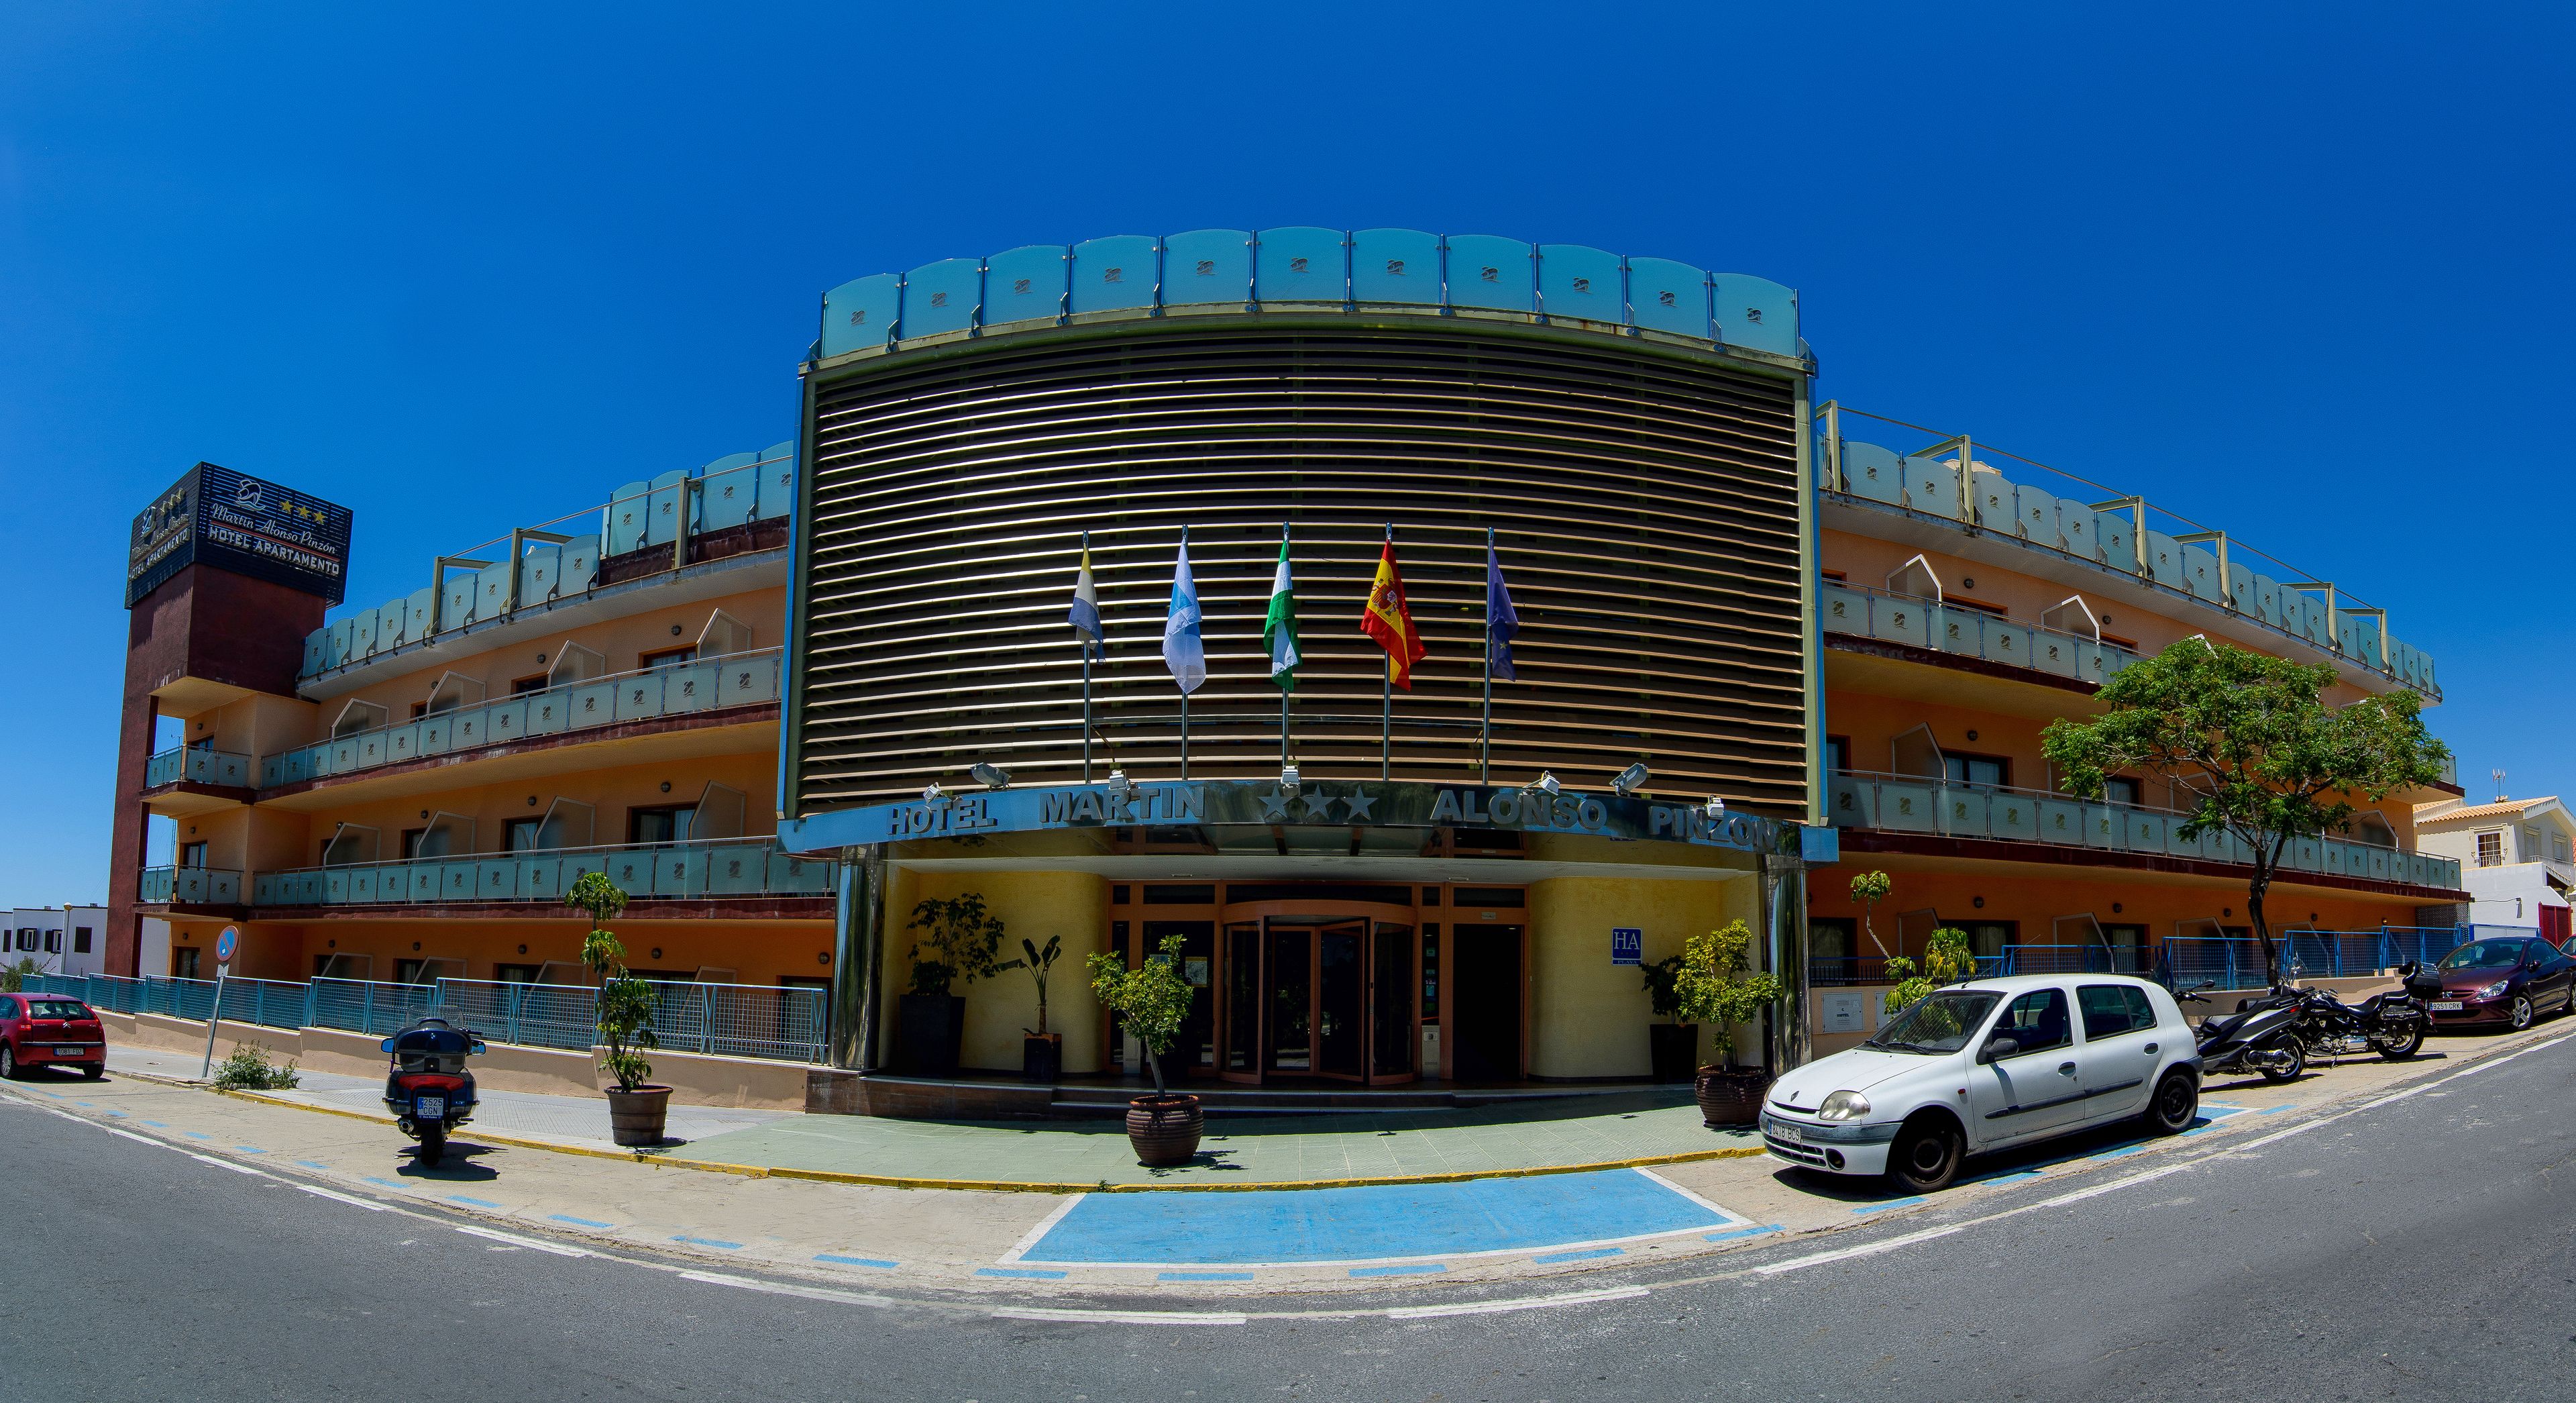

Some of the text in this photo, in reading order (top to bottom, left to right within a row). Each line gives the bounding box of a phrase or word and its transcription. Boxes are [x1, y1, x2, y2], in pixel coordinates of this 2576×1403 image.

[256, 519, 298, 542] Alonso
[299, 530, 337, 554] Pinzón
[208, 526, 250, 549] HOTEL
[254, 540, 339, 576] APARTAMENTO
[886, 786, 1778, 850] HOTEL MARTIN ALONSO PINZON
[1613, 931, 1640, 950] HA
[423, 1098, 443, 1106] 2525
[423, 1106, 438, 1115] CGN
[1772, 1124, 1800, 1141] 8418 BCS
